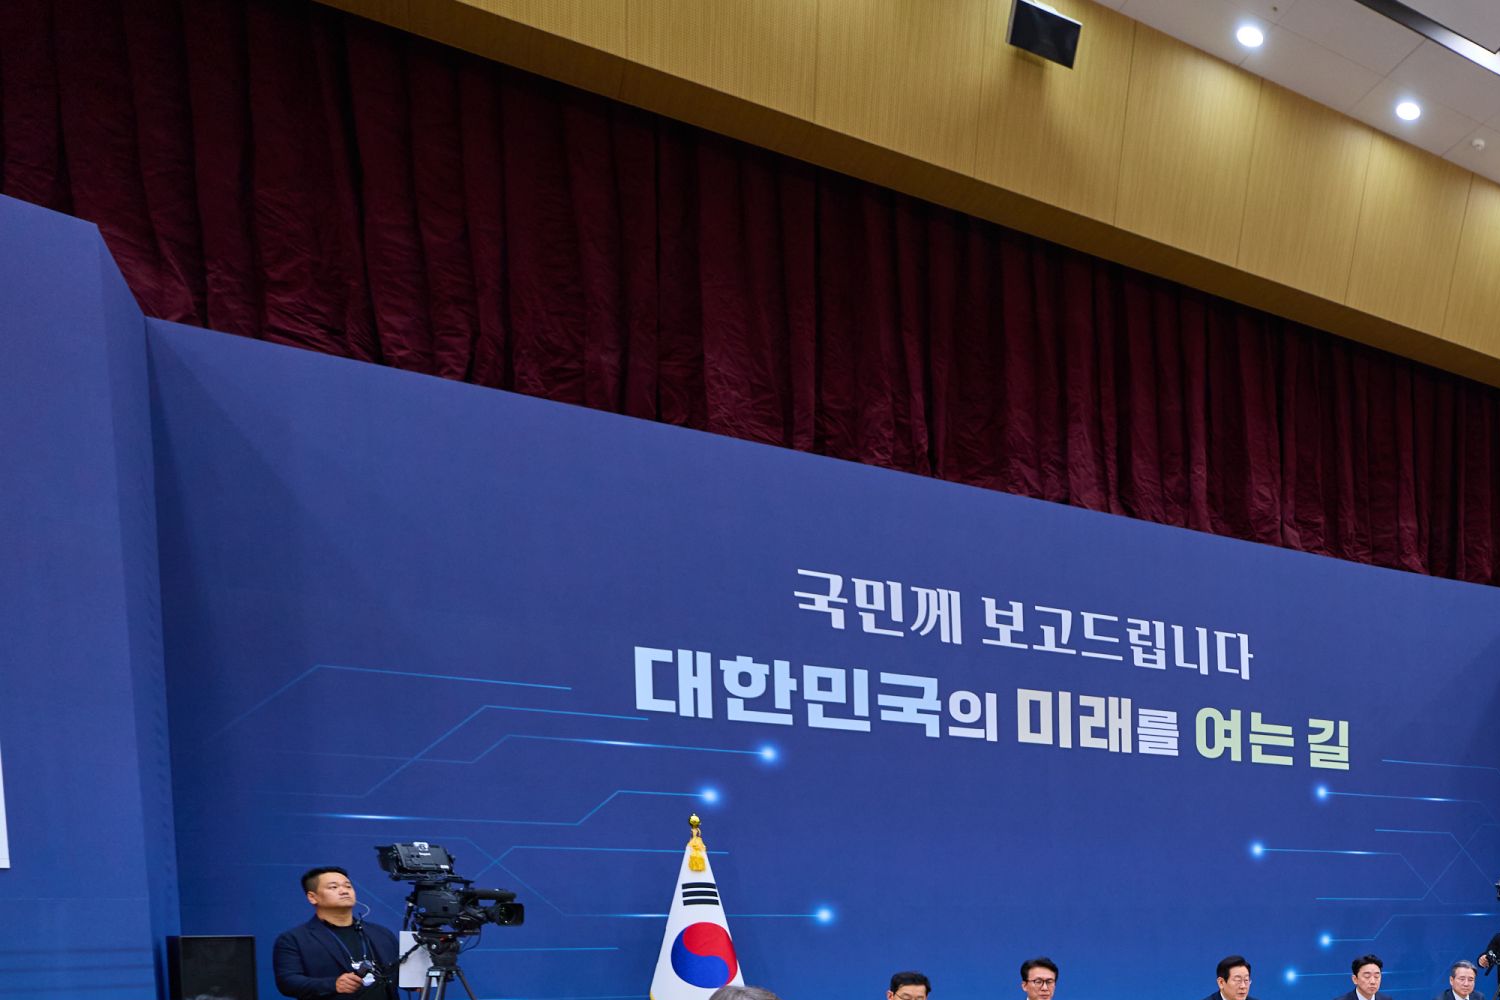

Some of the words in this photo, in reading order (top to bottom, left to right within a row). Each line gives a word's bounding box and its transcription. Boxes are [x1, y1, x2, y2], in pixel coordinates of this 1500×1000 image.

[793, 567, 963, 645] 국민께
[981, 597, 1254, 680] 보고드립니다
[633, 645, 998, 741] 대한민국의
[1017, 688, 1179, 757] 미래를
[1195, 706, 1294, 766] 여는
[1307, 718, 1350, 771] 길
